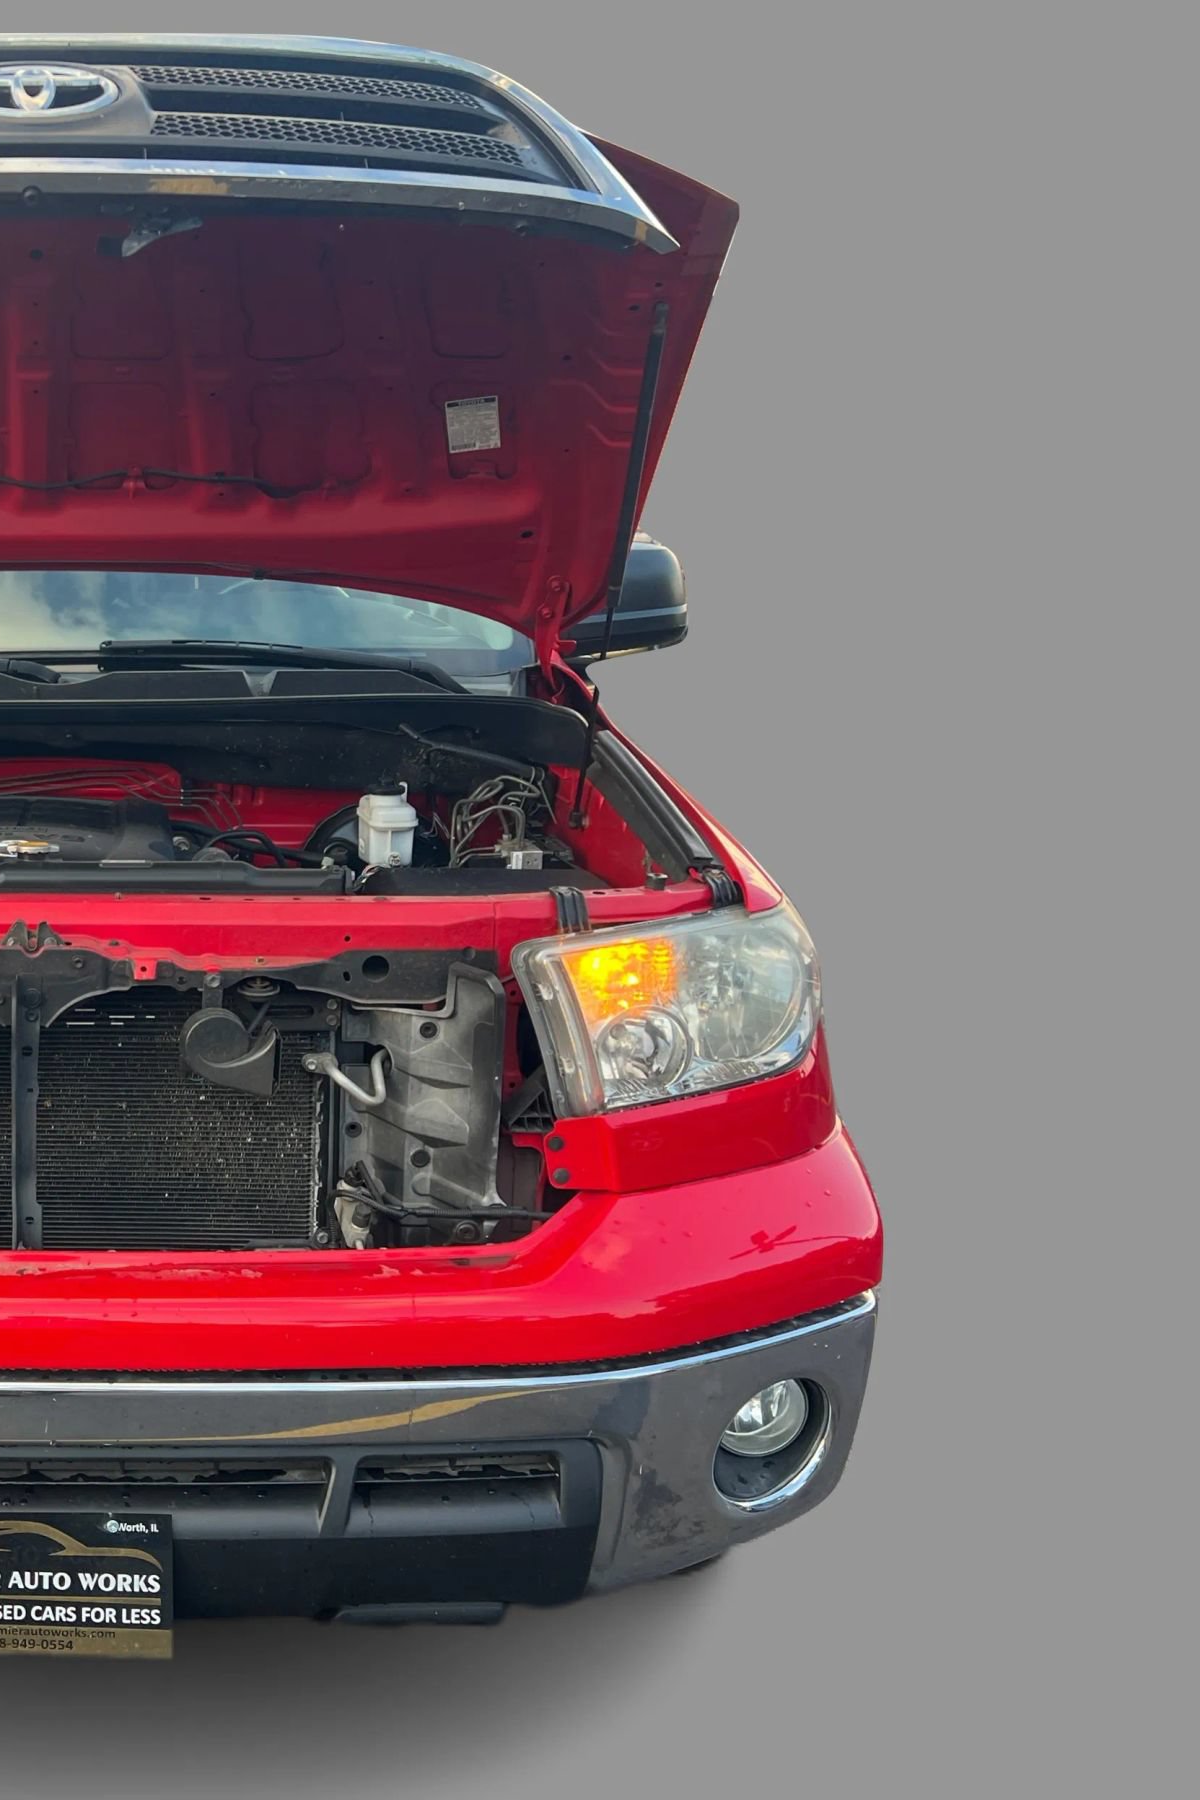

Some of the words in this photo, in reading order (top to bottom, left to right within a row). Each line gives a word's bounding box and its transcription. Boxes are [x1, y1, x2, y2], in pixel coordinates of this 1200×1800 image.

[150, 1523, 159, 1533] IL
[7, 1571, 72, 1591] AUTO
[77, 1572, 161, 1593] WORKS
[30, 1605, 77, 1622] CARS
[81, 1607, 117, 1624] FOR
[121, 1608, 161, 1625] LESS
